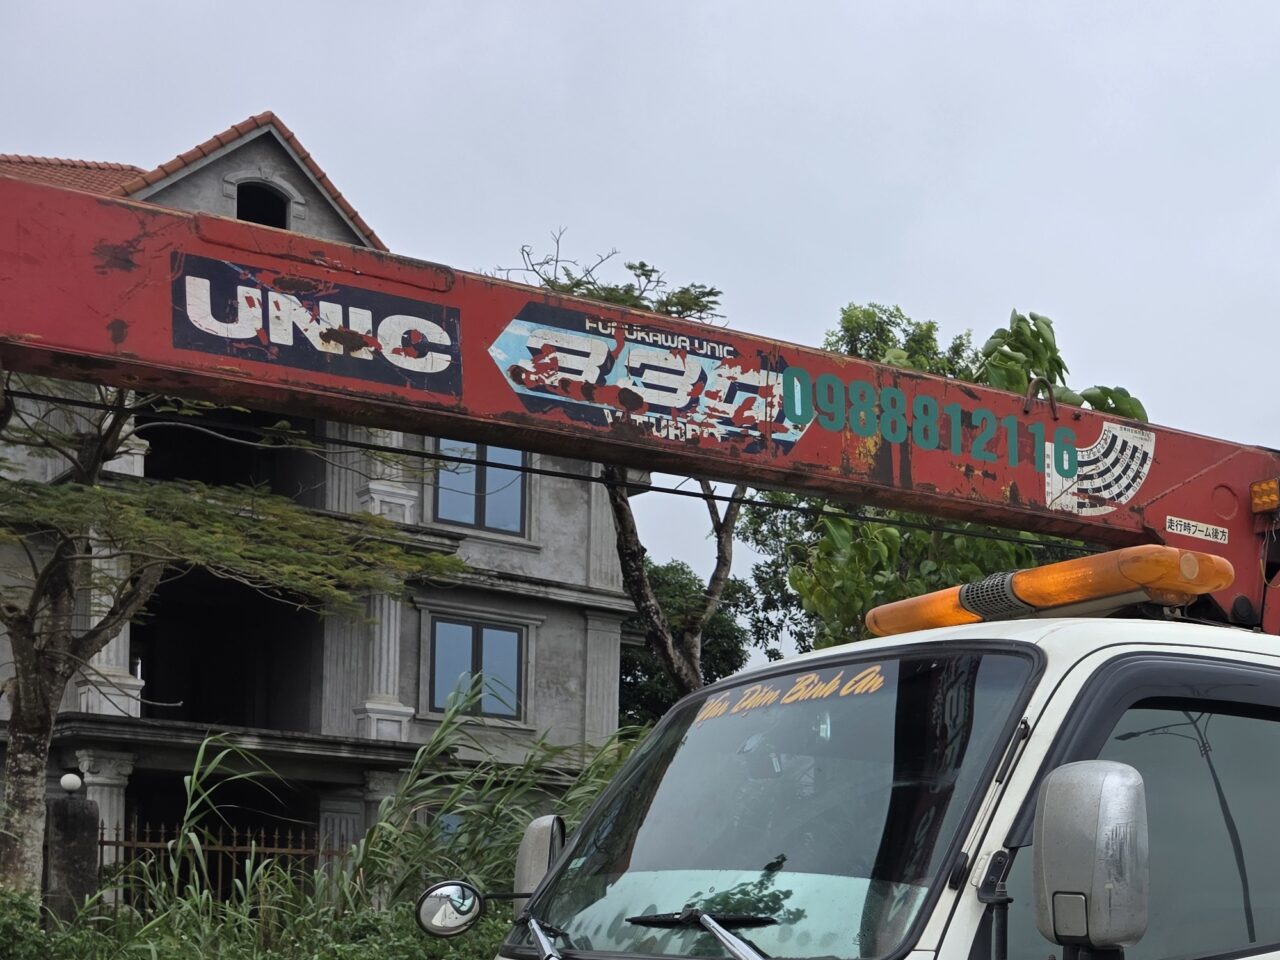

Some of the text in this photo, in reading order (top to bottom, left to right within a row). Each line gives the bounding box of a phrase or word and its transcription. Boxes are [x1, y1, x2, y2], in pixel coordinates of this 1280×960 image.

[185, 275, 452, 374] UNIC
[694, 339, 735, 360] UNIC
[782, 366, 1079, 479] 0988812116
[1167, 517, 1228, 542] 走行時ブーム後方
[780, 670, 844, 705] Bình
[839, 664, 886, 697] An
